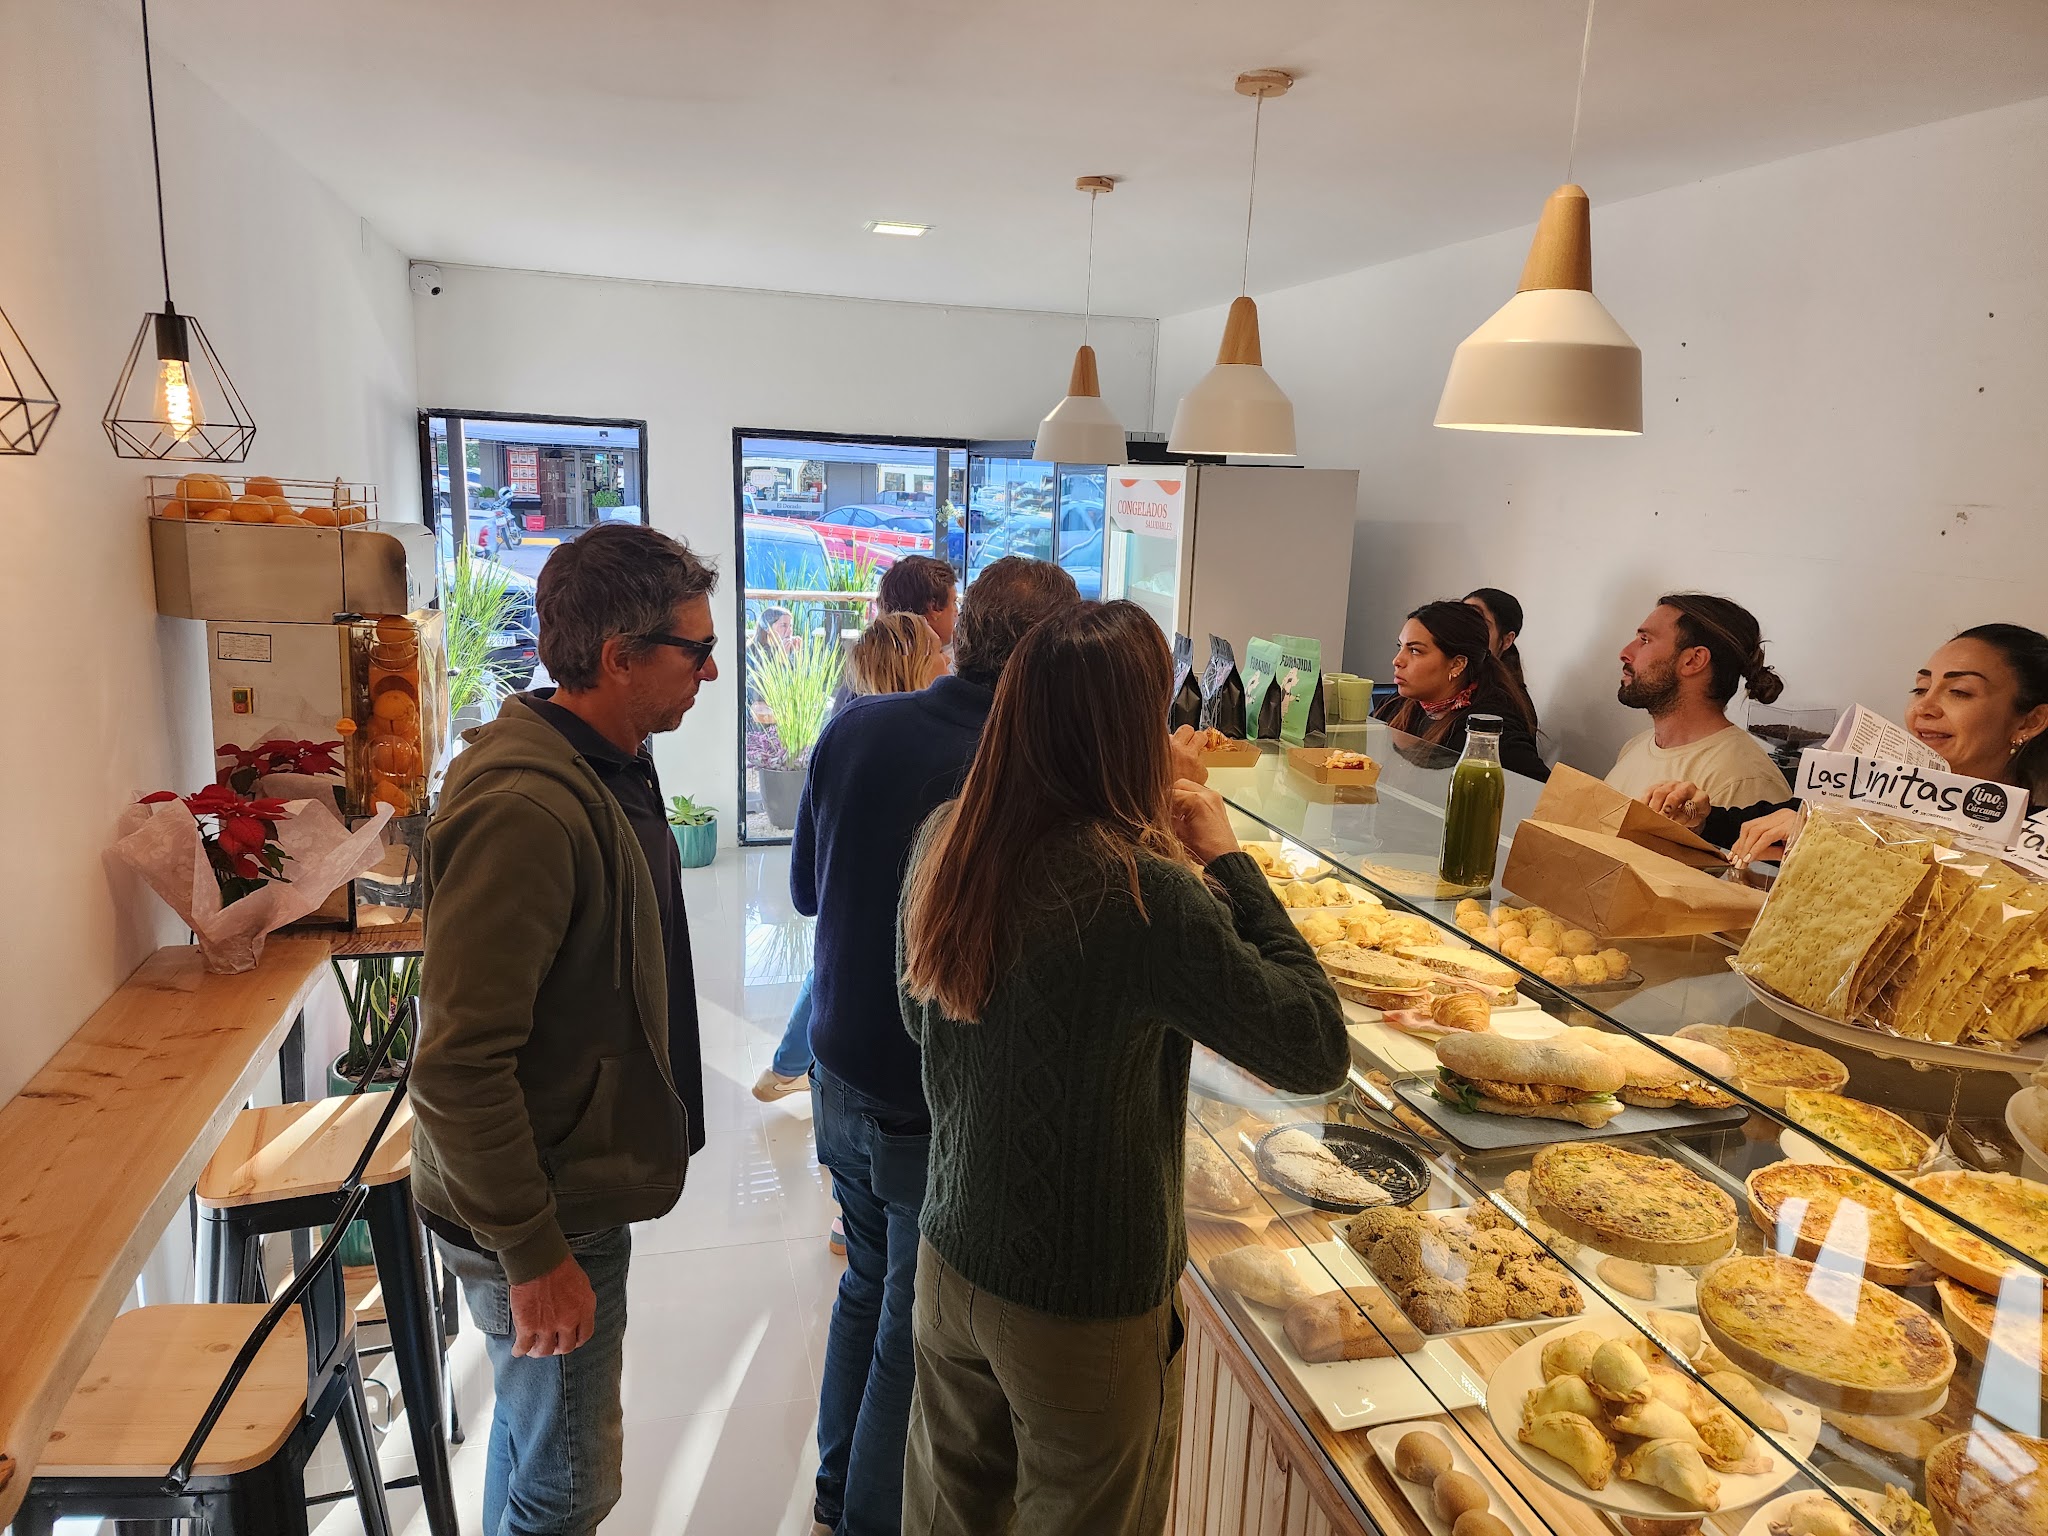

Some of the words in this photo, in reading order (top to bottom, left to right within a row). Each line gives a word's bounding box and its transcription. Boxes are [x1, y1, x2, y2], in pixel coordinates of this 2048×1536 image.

[1117, 500, 1168, 518] CONGELADOS
[1145, 520, 1172, 531] SALUDABLES
[1250, 656, 1271, 676] FORAJIDA
[1280, 655, 1312, 672] FORAJIDA
[1807, 761, 1847, 789] Las
[1849, 757, 1962, 811] Linitas
[1971, 786, 2002, 804] Lino
